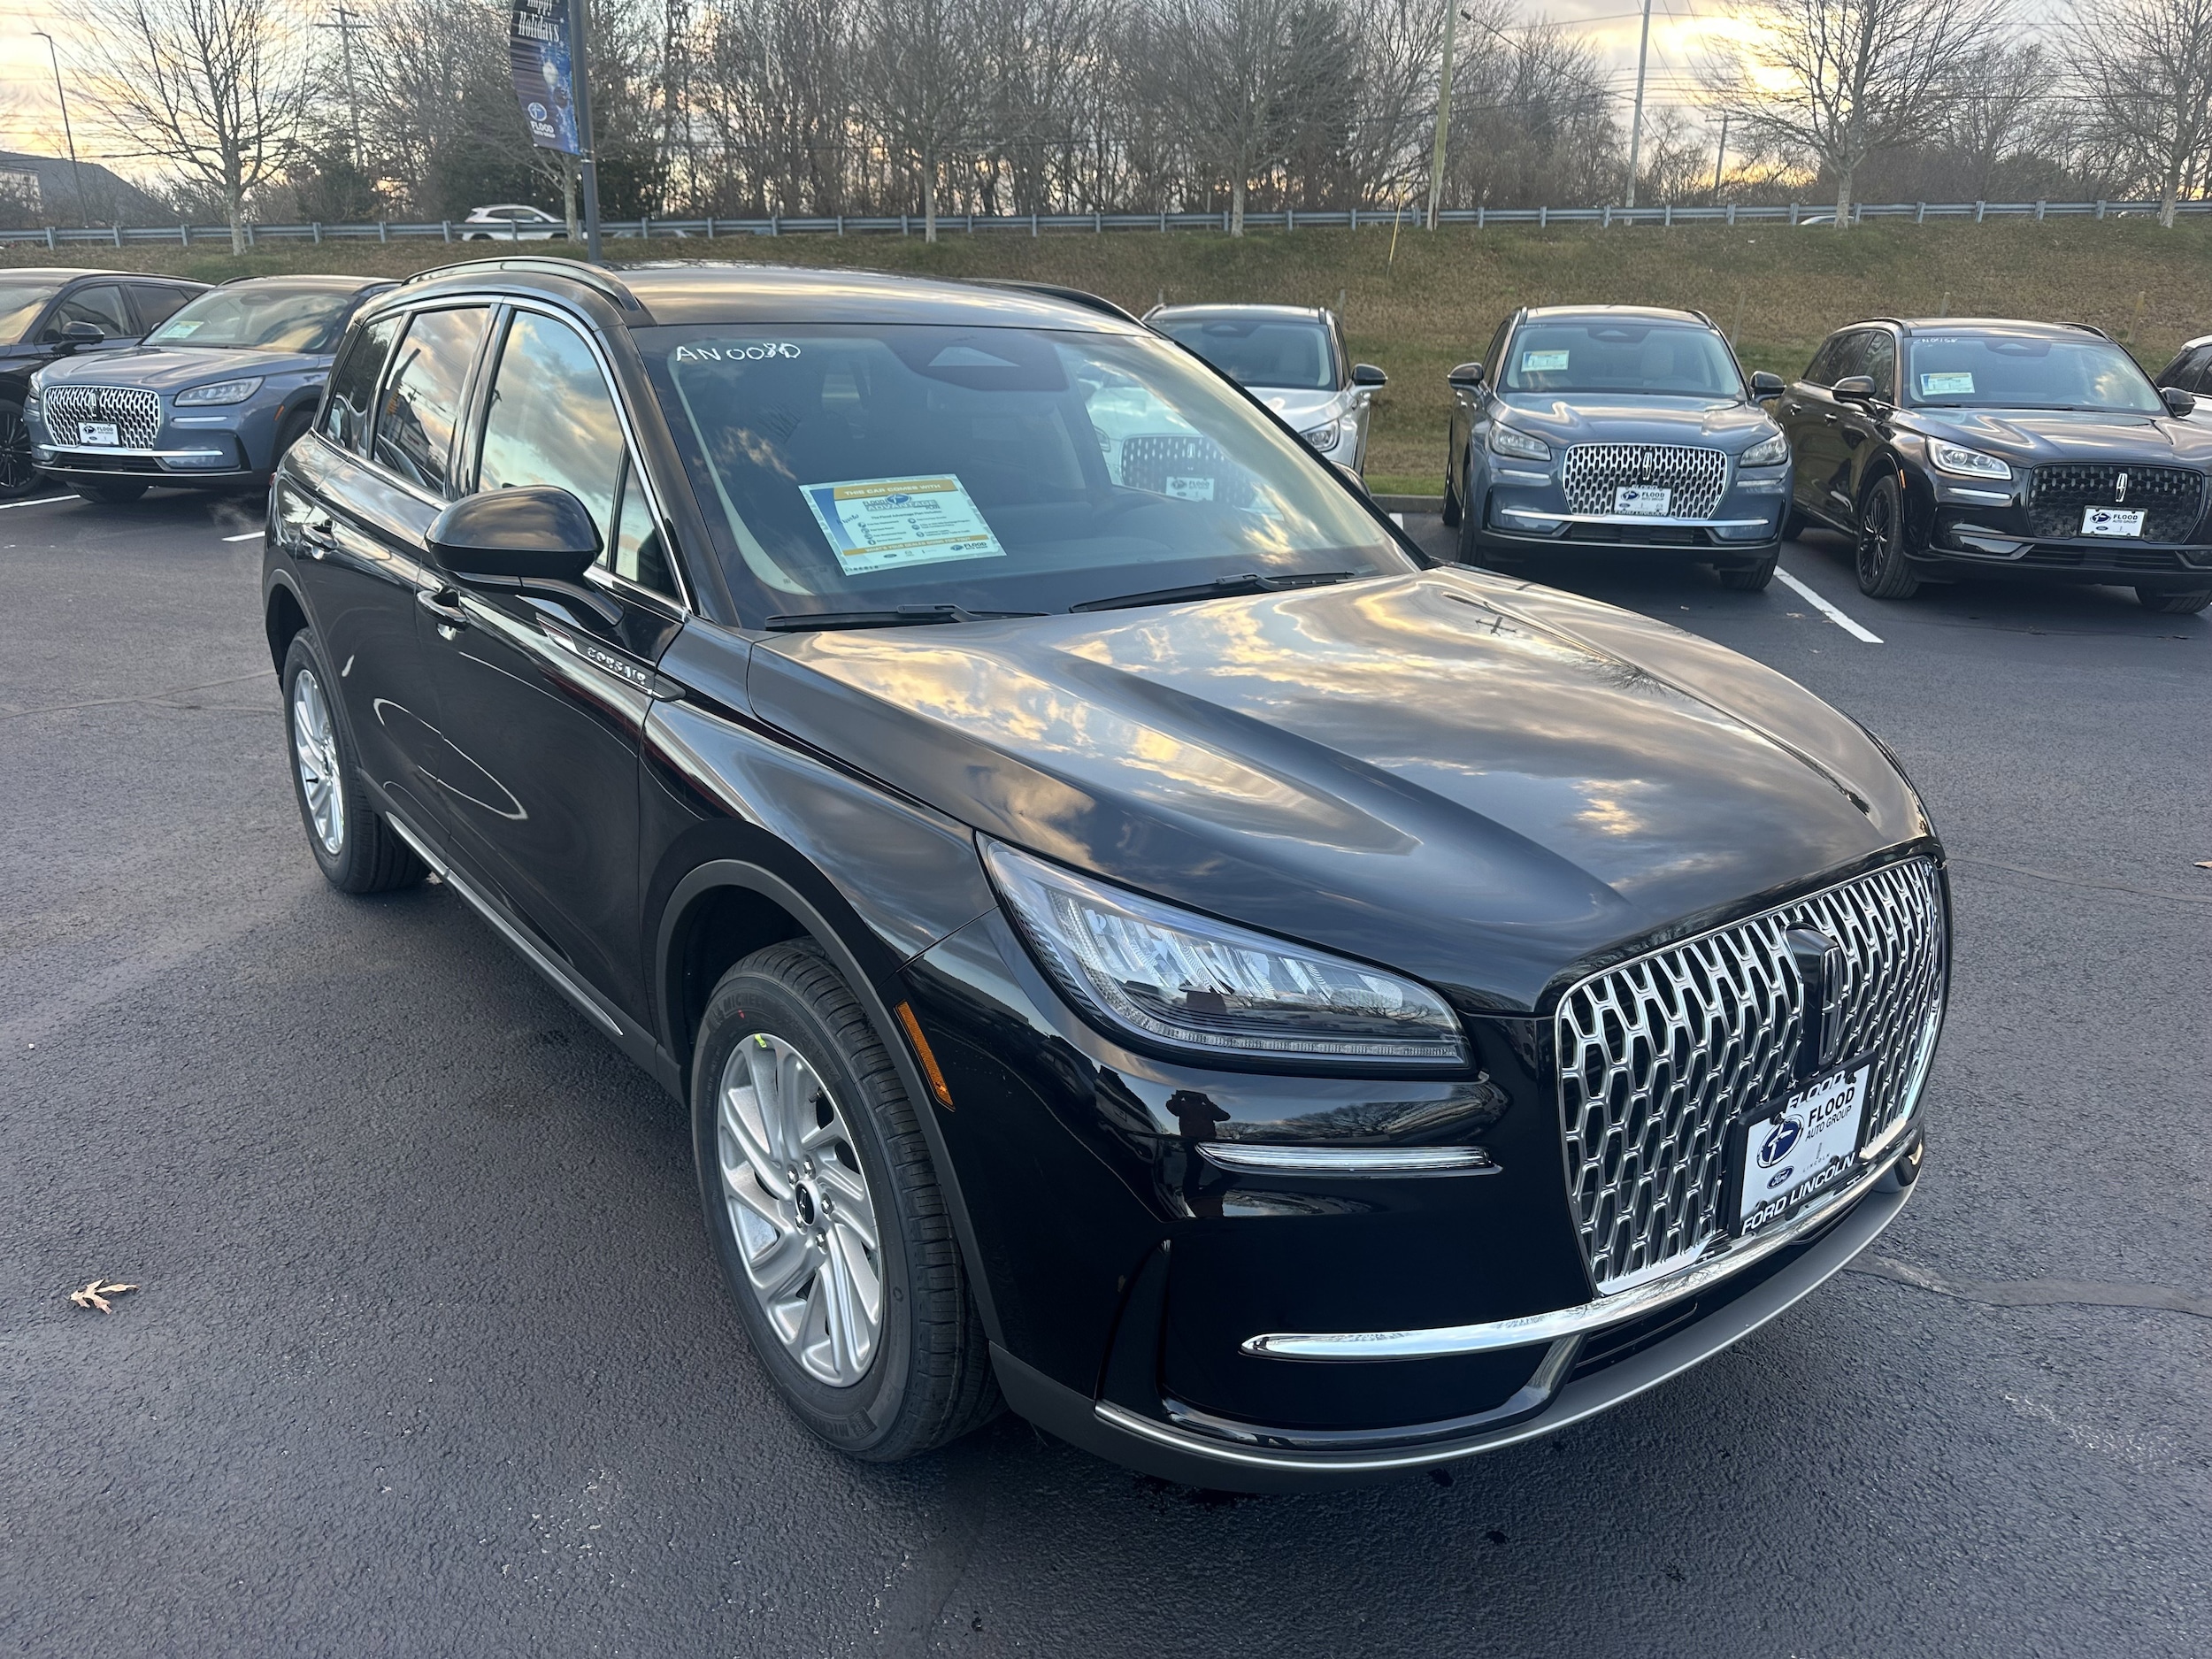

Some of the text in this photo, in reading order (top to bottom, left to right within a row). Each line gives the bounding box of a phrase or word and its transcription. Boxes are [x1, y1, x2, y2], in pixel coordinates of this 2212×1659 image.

[518, 11, 559, 45] Holidays
[530, 120, 555, 134] FLOOD
[867, 501, 938, 511] ADVANTAGE
[1787, 1069, 1846, 1109] FLOOD
[1805, 1105, 1852, 1142] AUTO GROUP
[1808, 1087, 1855, 1127] FLOOD
[1770, 1168, 1792, 1186] Ford
[1802, 1153, 1831, 1173] LINCOLN
[1741, 1152, 1856, 1236] FORD LINCOLN
